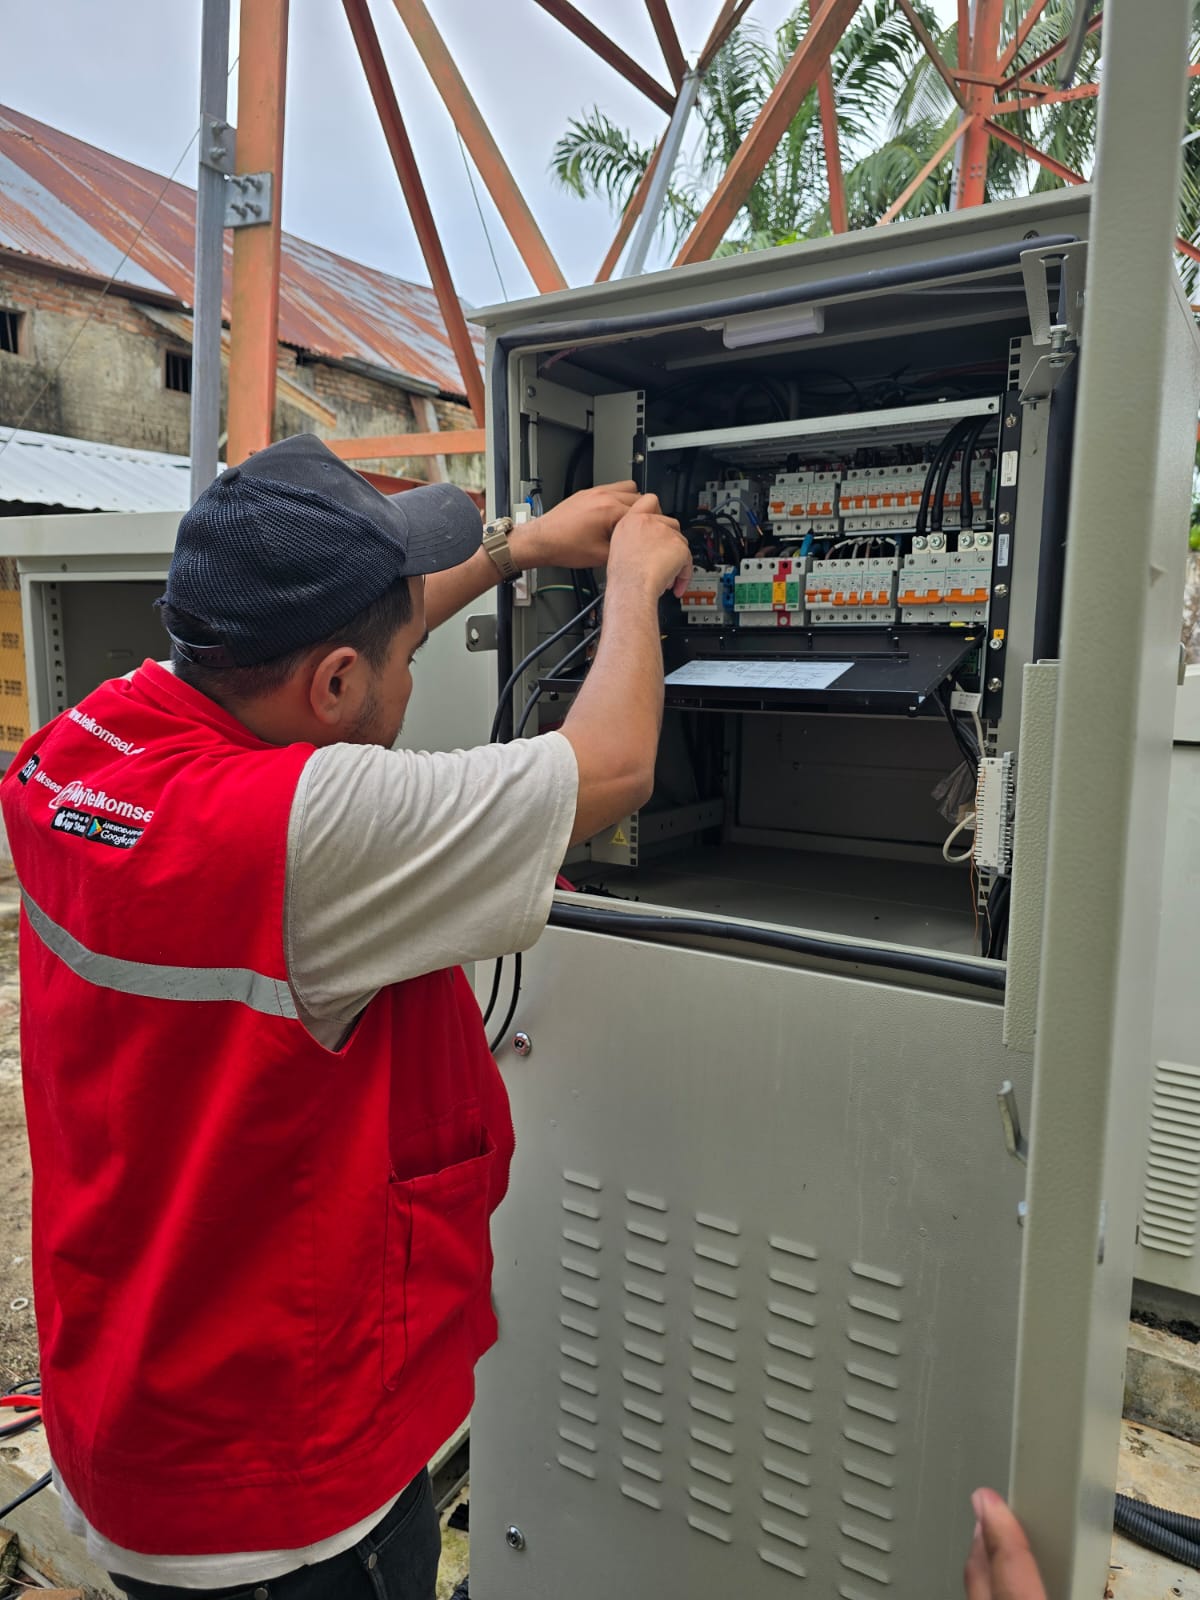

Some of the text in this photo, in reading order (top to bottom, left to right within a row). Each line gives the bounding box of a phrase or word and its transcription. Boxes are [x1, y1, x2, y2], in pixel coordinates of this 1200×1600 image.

[34, 770, 63, 793] Akses
[69, 786, 155, 823] MyTelkomse
[100, 830, 127, 846] Google
